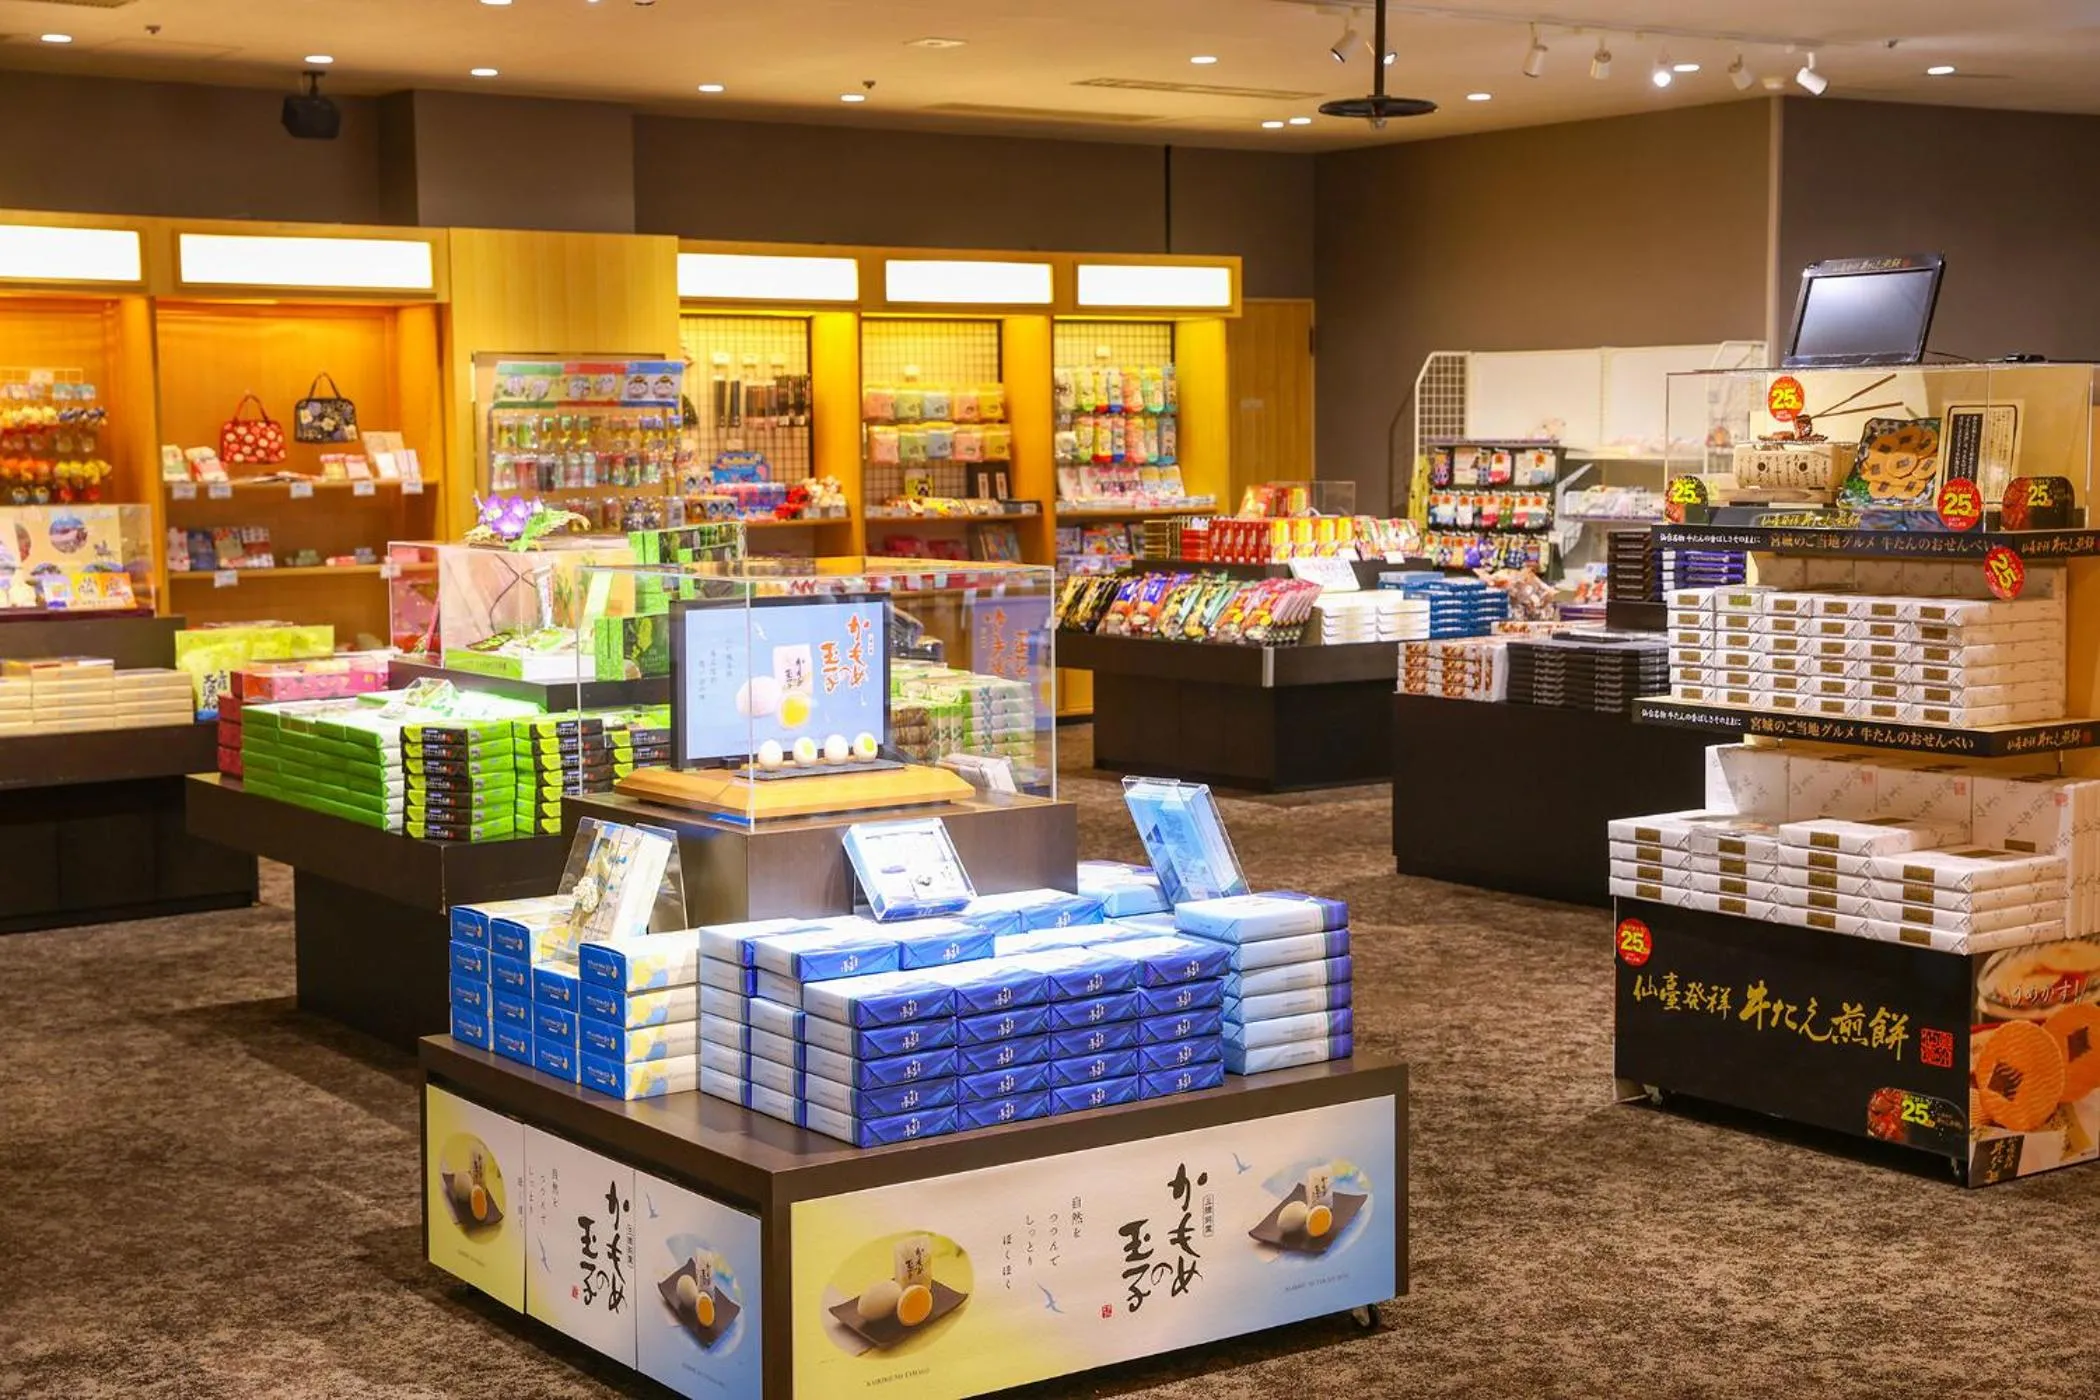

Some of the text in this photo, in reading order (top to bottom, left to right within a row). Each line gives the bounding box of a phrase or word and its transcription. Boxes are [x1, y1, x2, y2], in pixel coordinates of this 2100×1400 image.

[1772, 387, 1797, 410] 25
[1672, 481, 1697, 504] 25
[1943, 493, 1972, 516] 25
[2027, 485, 2048, 506] 25
[1769, 534, 1998, 552] 宮城のご当地グルメ 牛たんのおせんべい
[1989, 553, 2017, 590] 25
[1750, 718, 1975, 751] 宮城のご当地グルメ 牛たんのおせんべい
[1620, 930, 1644, 953] 25
[1901, 1099, 1930, 1125] 25
[1071, 1195, 1083, 1238] 自然を
[1025, 1214, 1035, 1266] しっとり
[1002, 1233, 1013, 1290] ほくほく
